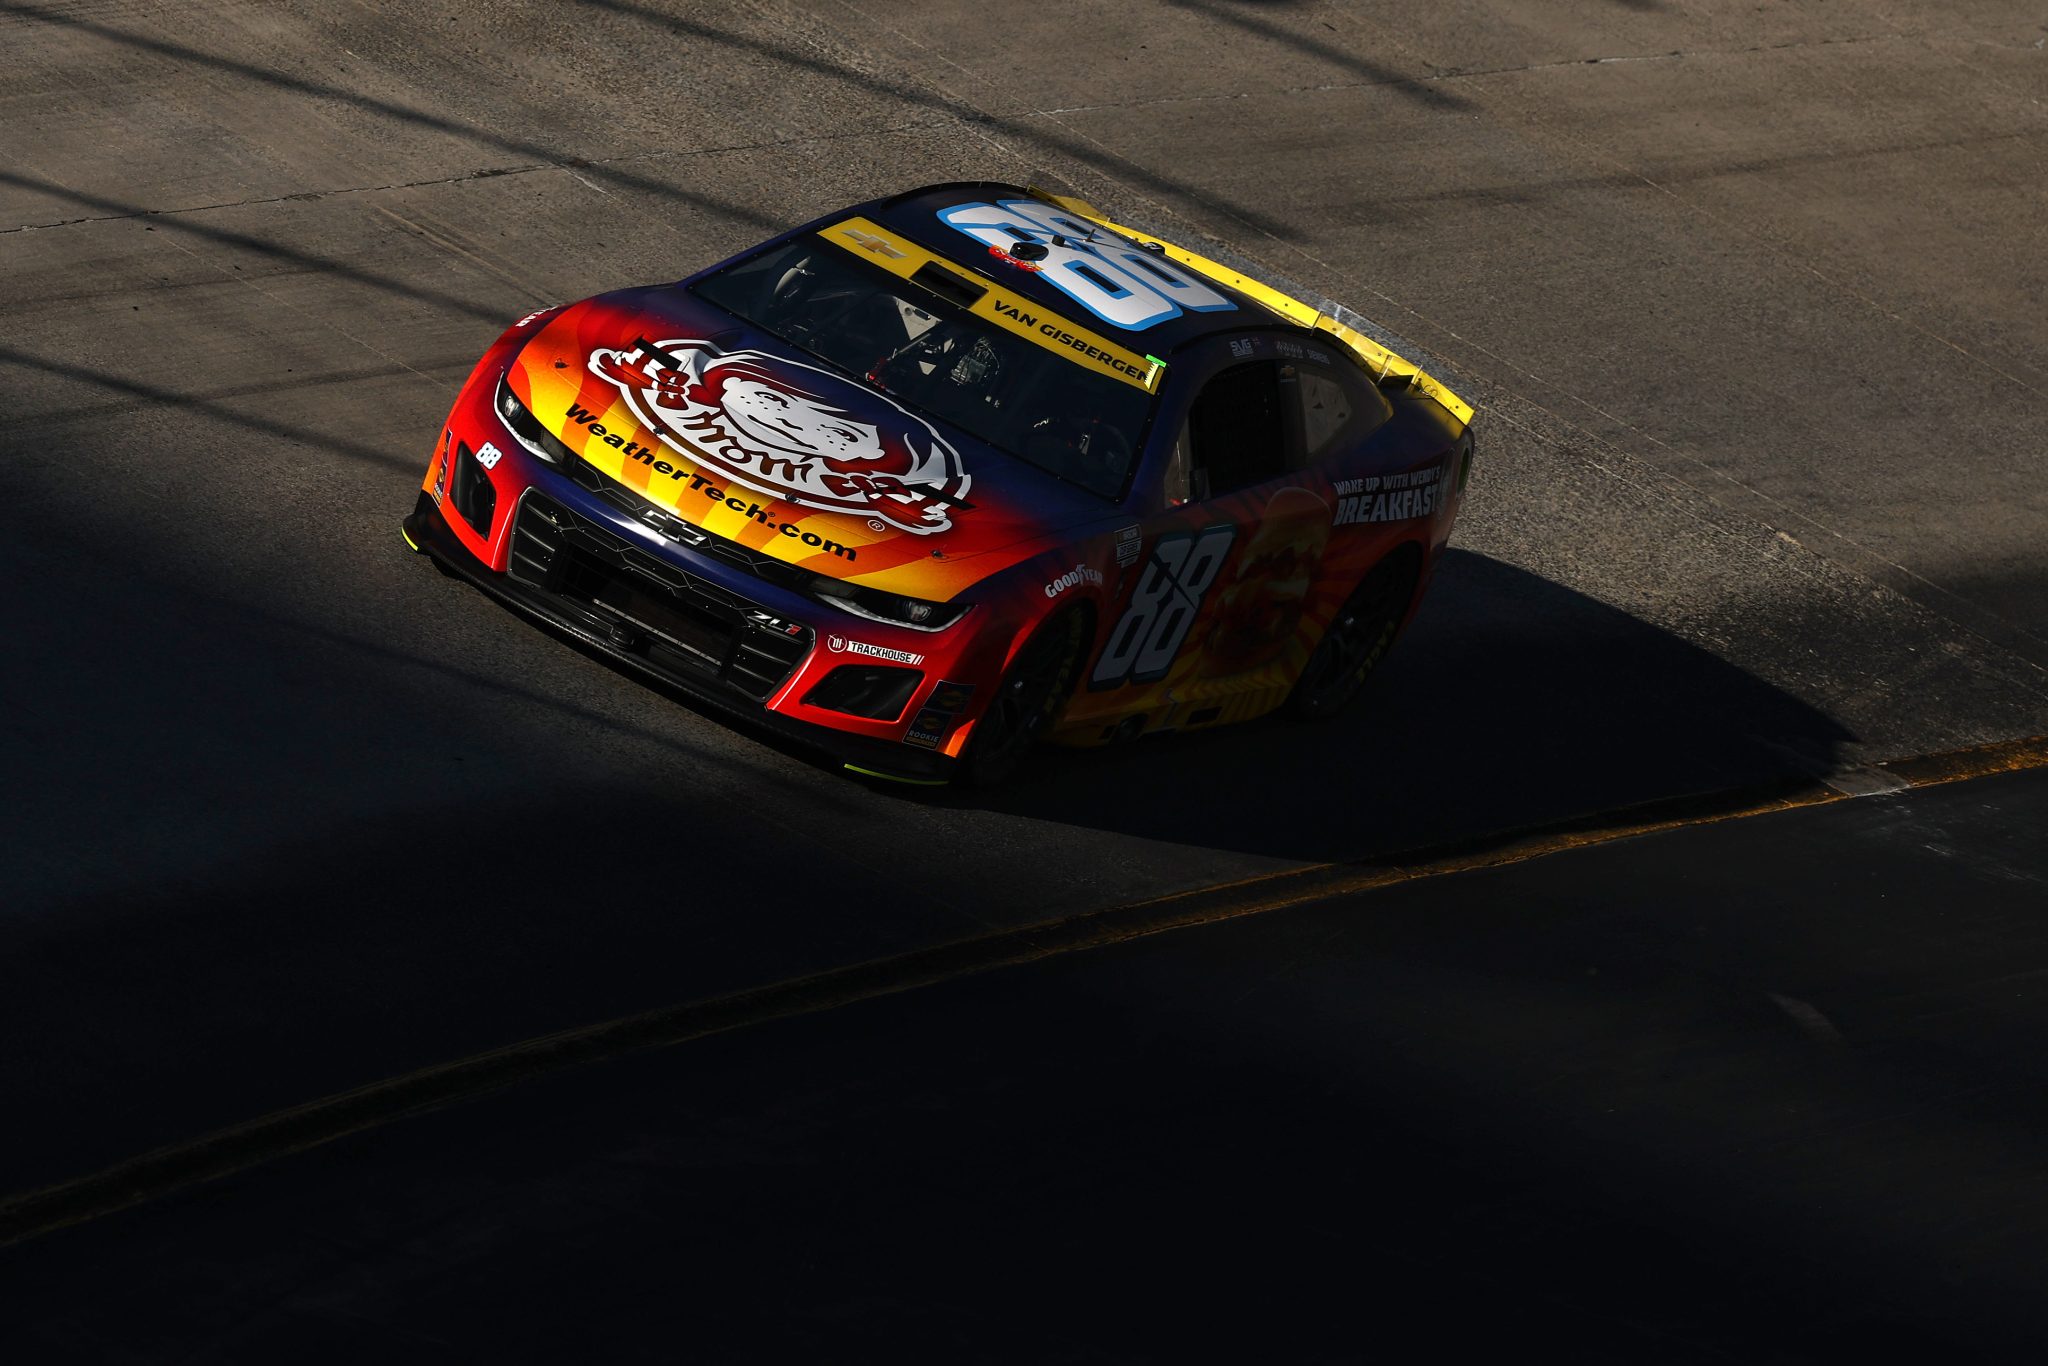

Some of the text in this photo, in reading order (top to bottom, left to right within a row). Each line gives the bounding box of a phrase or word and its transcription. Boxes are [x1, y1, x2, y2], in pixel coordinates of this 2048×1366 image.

[936, 198, 1239, 332] 88
[994, 300, 1038, 327] VAN
[475, 441, 502, 470] 88
[565, 403, 857, 562] WeatherTech.com
[1333, 479, 1364, 496] WAKE
[1365, 477, 1381, 492] UP
[1383, 473, 1409, 490] WITH
[1332, 484, 1440, 528] BREAKFAST
[1089, 525, 1237, 691] 88
[851, 642, 912, 663] TRACKHOUSE
[908, 729, 940, 743] ROOKIE
